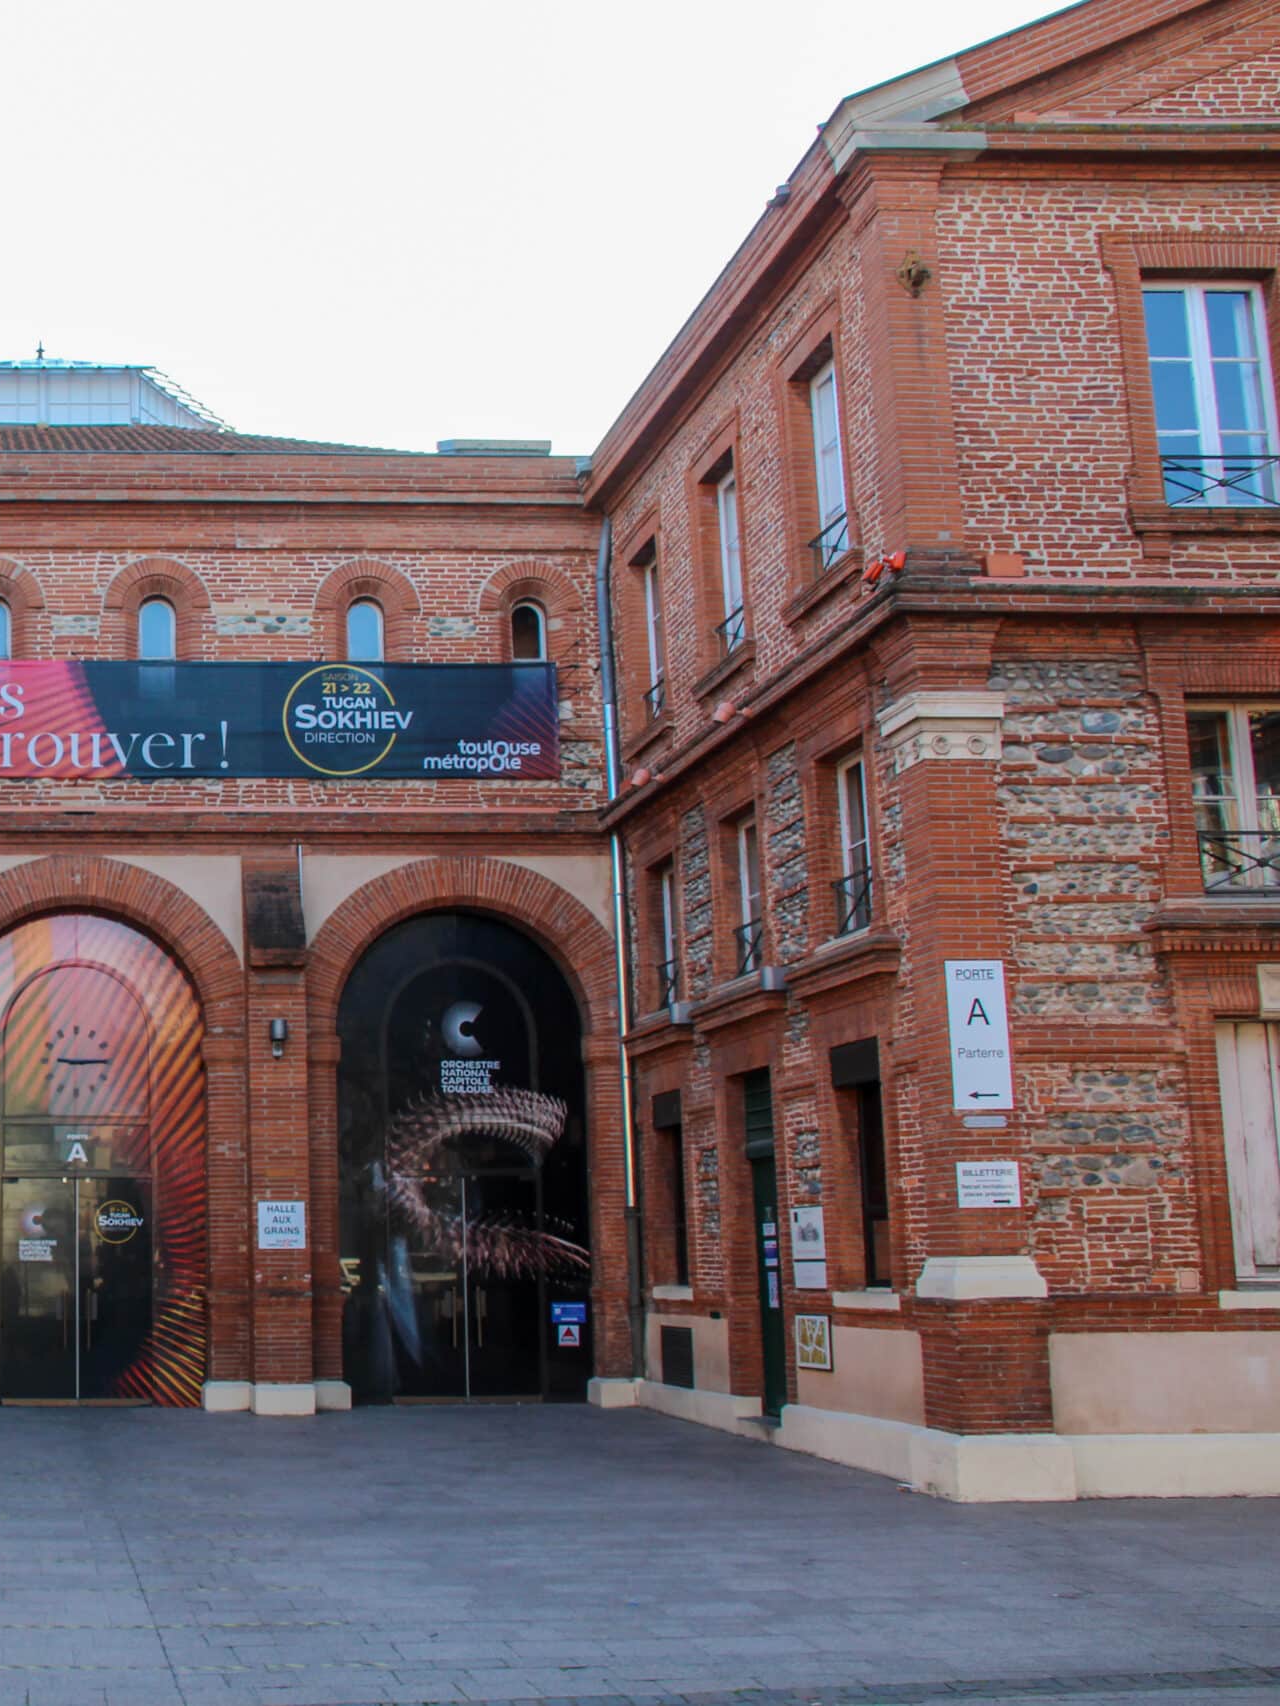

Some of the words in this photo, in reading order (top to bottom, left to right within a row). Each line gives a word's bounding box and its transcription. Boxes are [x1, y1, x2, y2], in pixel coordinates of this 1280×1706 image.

[322, 682, 337, 694] 21
[353, 682, 371, 694] 22
[322, 696, 377, 709] TUGAN
[295, 704, 413, 729] SOKHIEV
[305, 732, 376, 743] DIRECTION
[955, 968, 995, 980] PORTE
[966, 997, 991, 1026] A
[958, 1047, 1004, 1058] Parterre
[440, 1060, 501, 1069] ORCHESTRE
[441, 1068, 492, 1077] NATIONAL
[441, 1077, 490, 1085] CAPITOLE
[441, 1085, 494, 1094] TOULOUSE
[66, 1142, 89, 1162] A
[962, 1168, 1014, 1177] BILLETTERIE
[266, 1204, 297, 1213] HALLE
[272, 1215, 292, 1224] AUX
[263, 1226, 300, 1235] GRAINS
